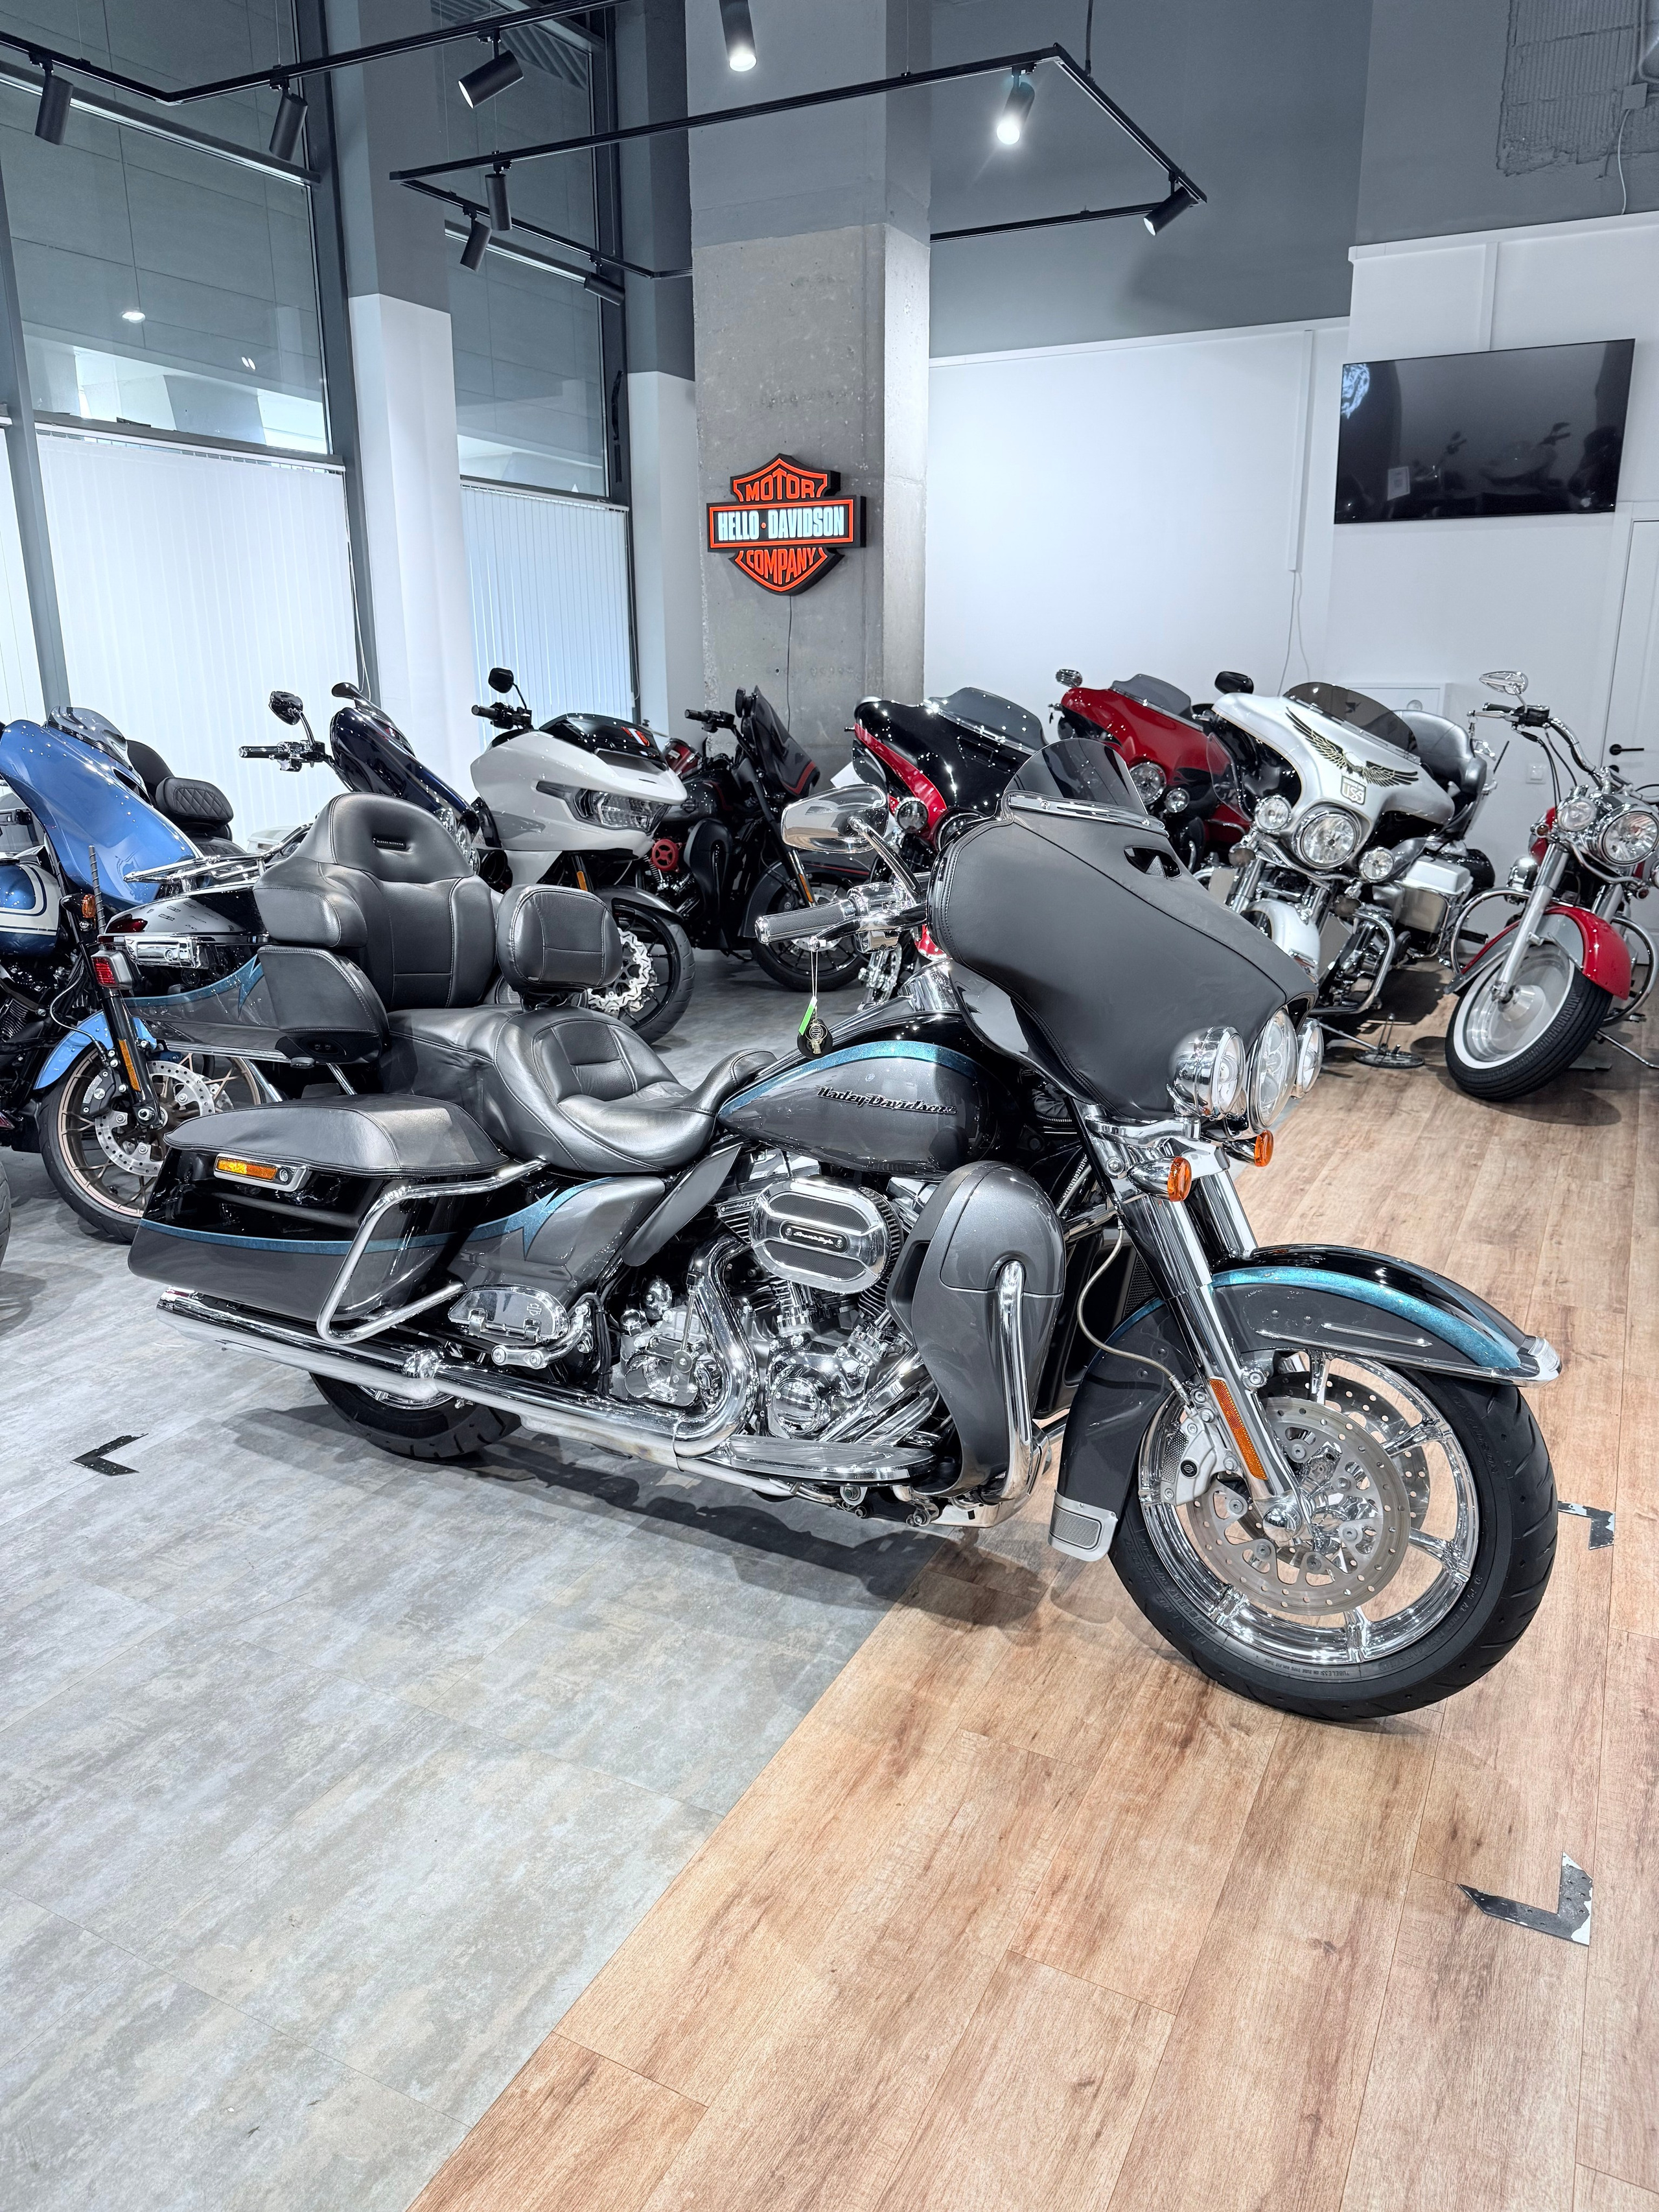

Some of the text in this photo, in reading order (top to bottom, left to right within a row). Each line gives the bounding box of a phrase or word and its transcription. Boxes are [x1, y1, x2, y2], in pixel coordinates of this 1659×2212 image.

[745, 467, 815, 502] MOTOR
[717, 506, 844, 541] HELLO DAVIDSON
[745, 546, 817, 585] COMPANY
[815, 1084, 958, 1115] Harley-Davidson
